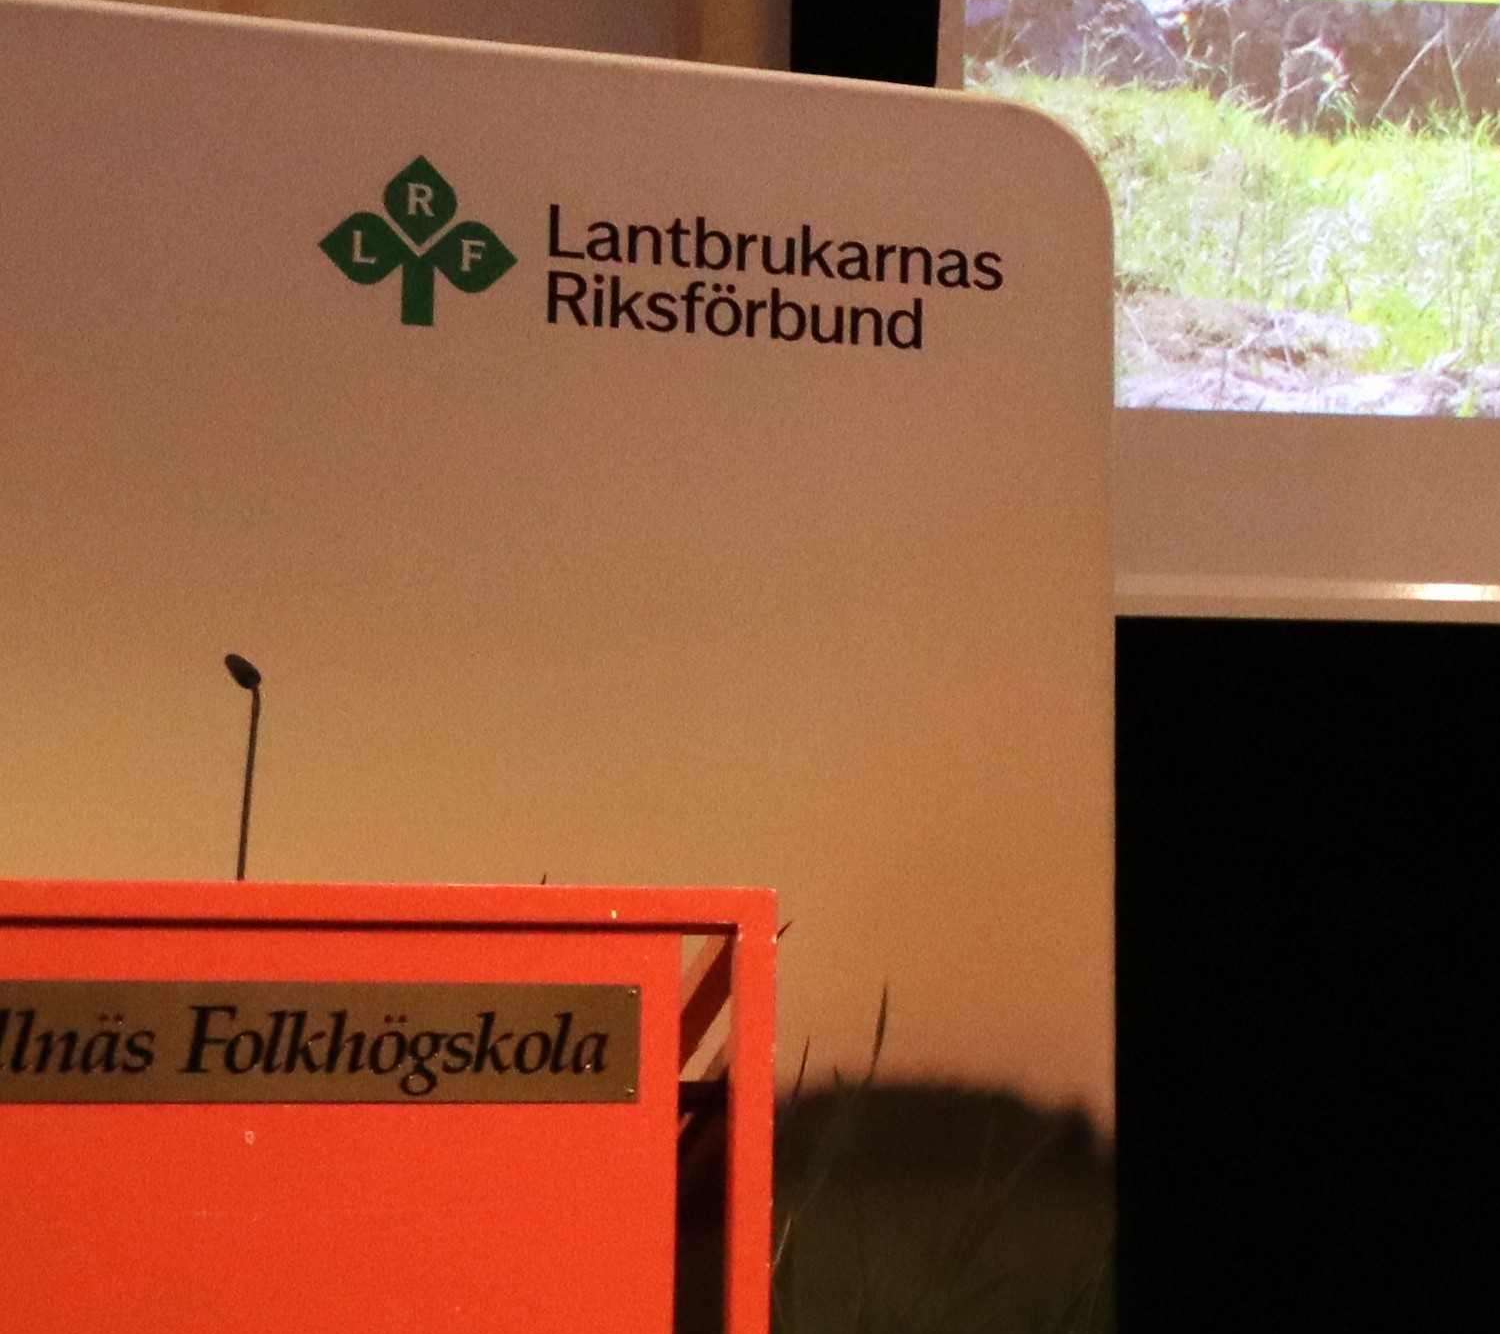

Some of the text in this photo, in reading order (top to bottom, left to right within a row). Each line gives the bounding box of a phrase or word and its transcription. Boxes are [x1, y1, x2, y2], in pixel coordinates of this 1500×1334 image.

[547, 203, 1004, 291] Lantbrukarnas
[546, 270, 923, 350] Riksförbund
[181, 1004, 610, 1096] Folkhögskola
